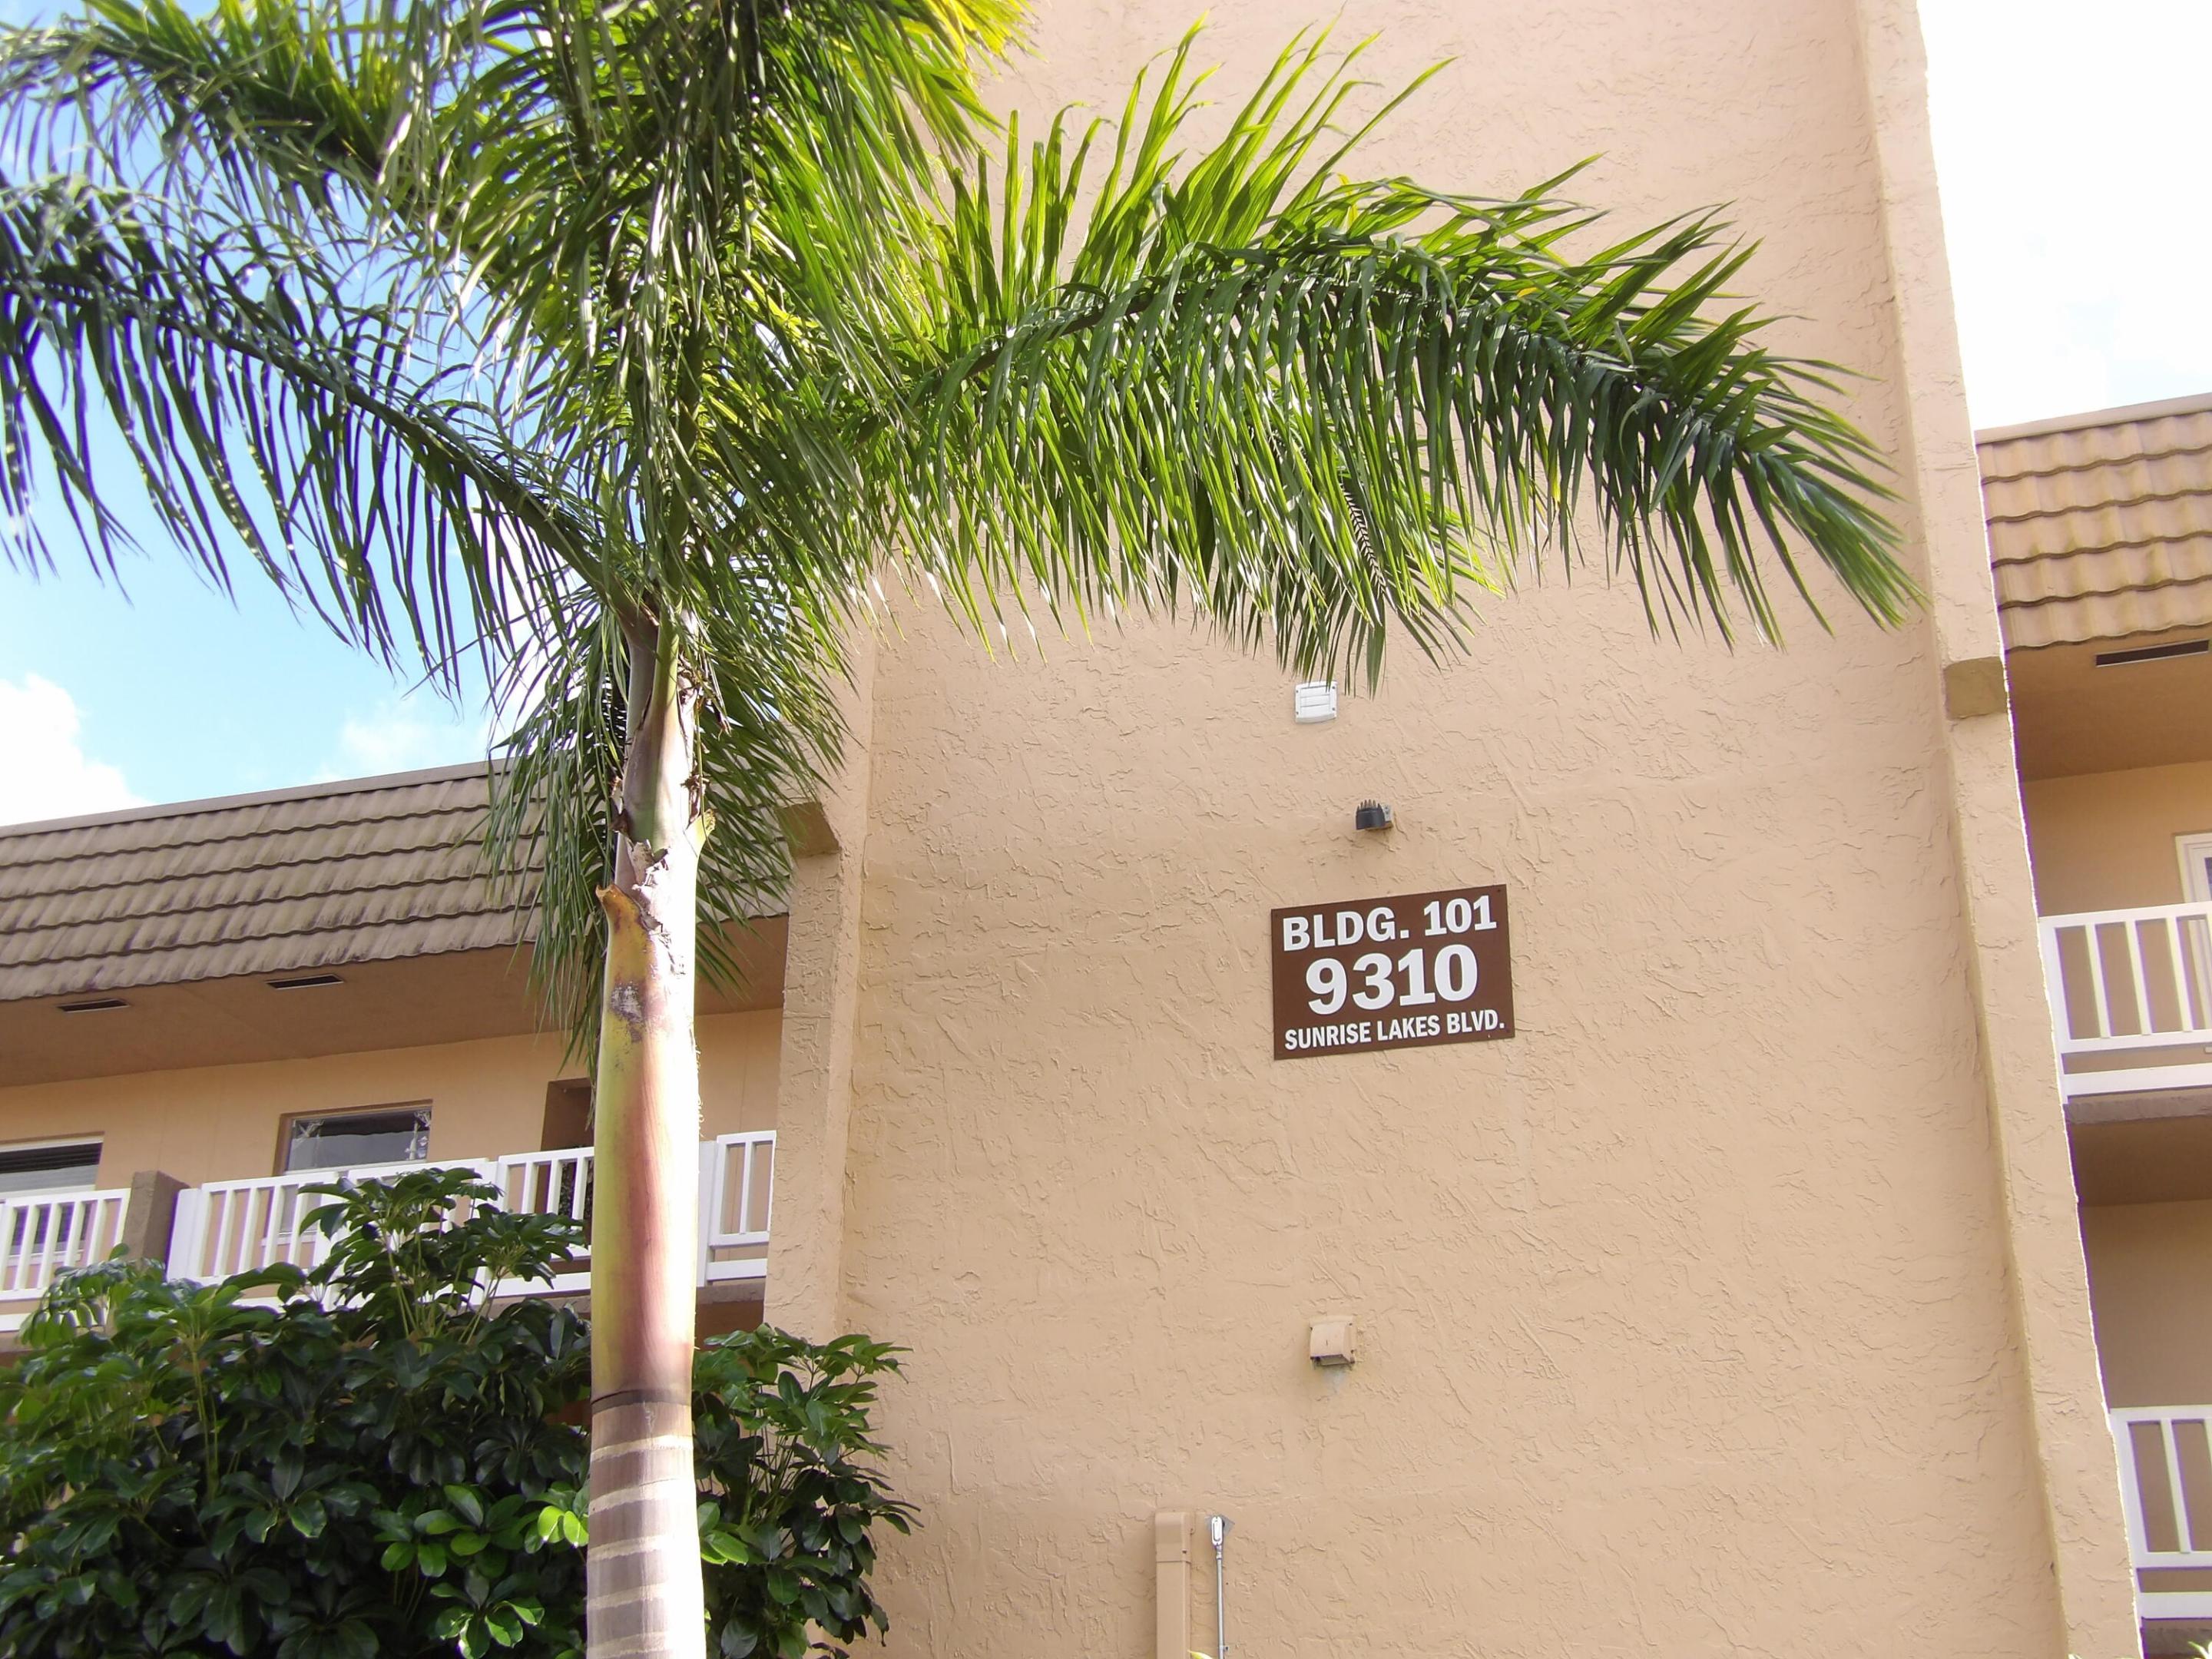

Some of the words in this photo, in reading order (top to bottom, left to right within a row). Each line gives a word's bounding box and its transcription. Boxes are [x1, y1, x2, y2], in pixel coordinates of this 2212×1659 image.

[1283, 907, 1410, 952] BLDG.
[1423, 895, 1498, 936] 101
[1305, 944, 1479, 1015] 9310
[1284, 1022, 1372, 1051] SUNRISE
[1376, 1015, 1441, 1041] LAKES
[1446, 1009, 1505, 1035] BLVD.
